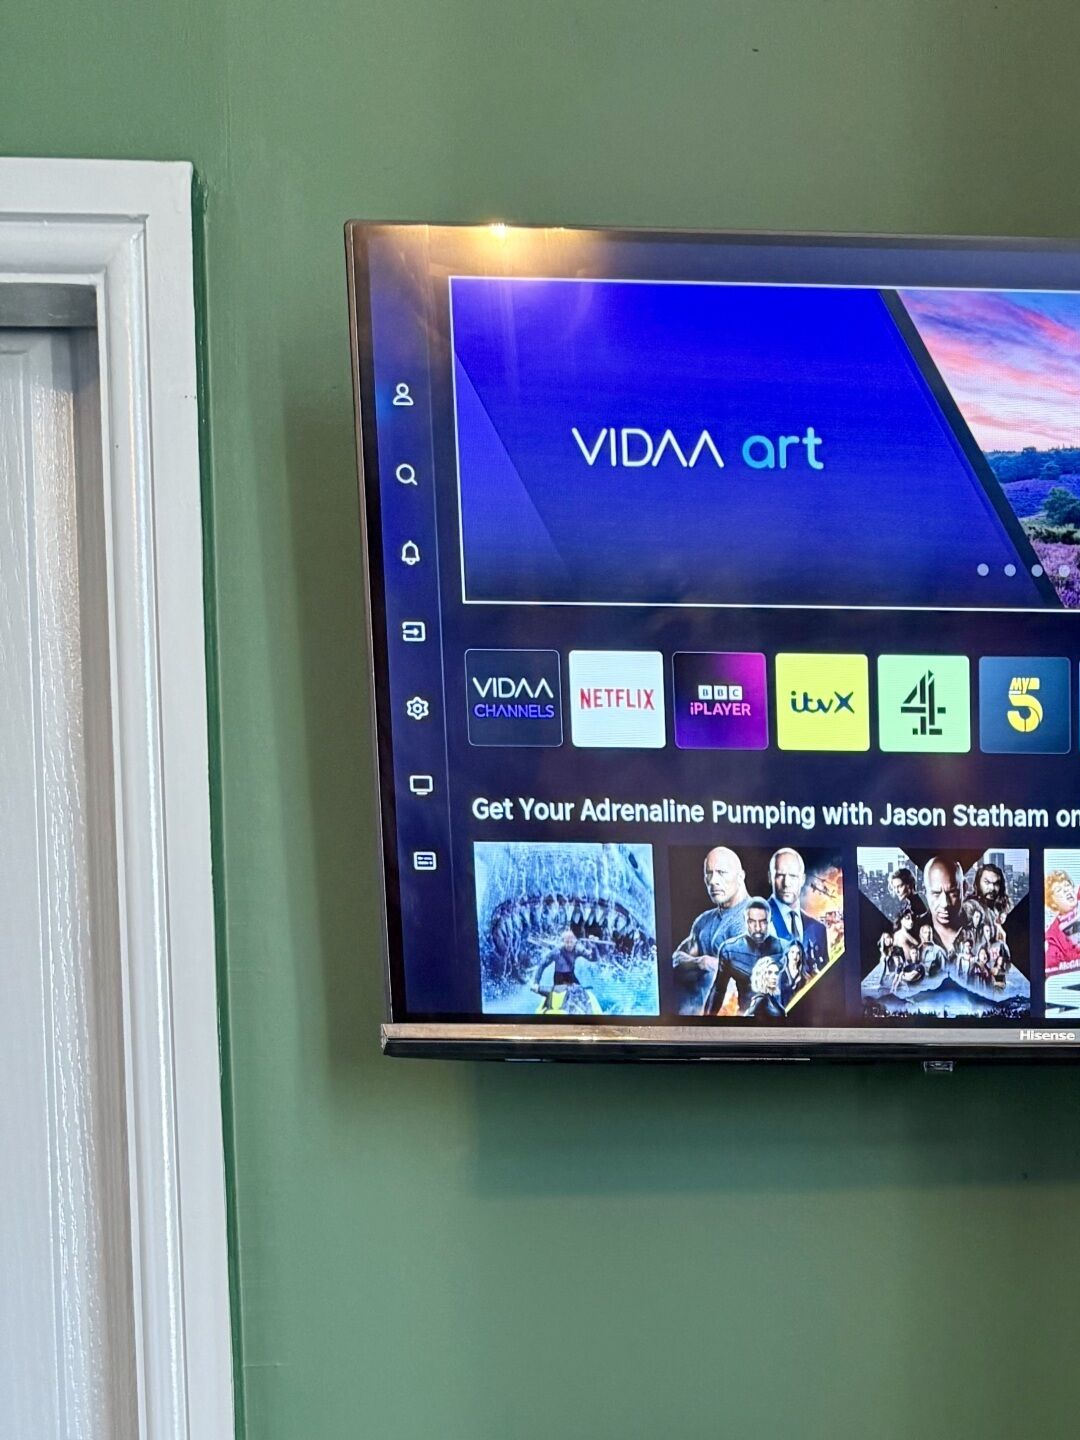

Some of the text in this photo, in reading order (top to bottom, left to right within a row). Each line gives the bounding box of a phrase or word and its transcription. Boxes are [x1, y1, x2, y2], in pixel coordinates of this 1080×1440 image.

[571, 427, 824, 470] VIDAA art
[472, 677, 554, 699] VIDAA
[580, 687, 655, 710] NETFLIX
[698, 684, 743, 700] BBC
[474, 703, 555, 718] CHANNELS
[690, 702, 752, 717] iPLAYER
[790, 690, 855, 714] itvX
[472, 798, 513, 821] Get
[518, 798, 575, 821] Your
[580, 799, 704, 822] Adrenaline
[712, 800, 816, 829] Pumping
[823, 802, 873, 826] with
[880, 803, 946, 826] Jason
[953, 804, 1048, 827] Statham
[1020, 1029, 1076, 1040] Hisense
